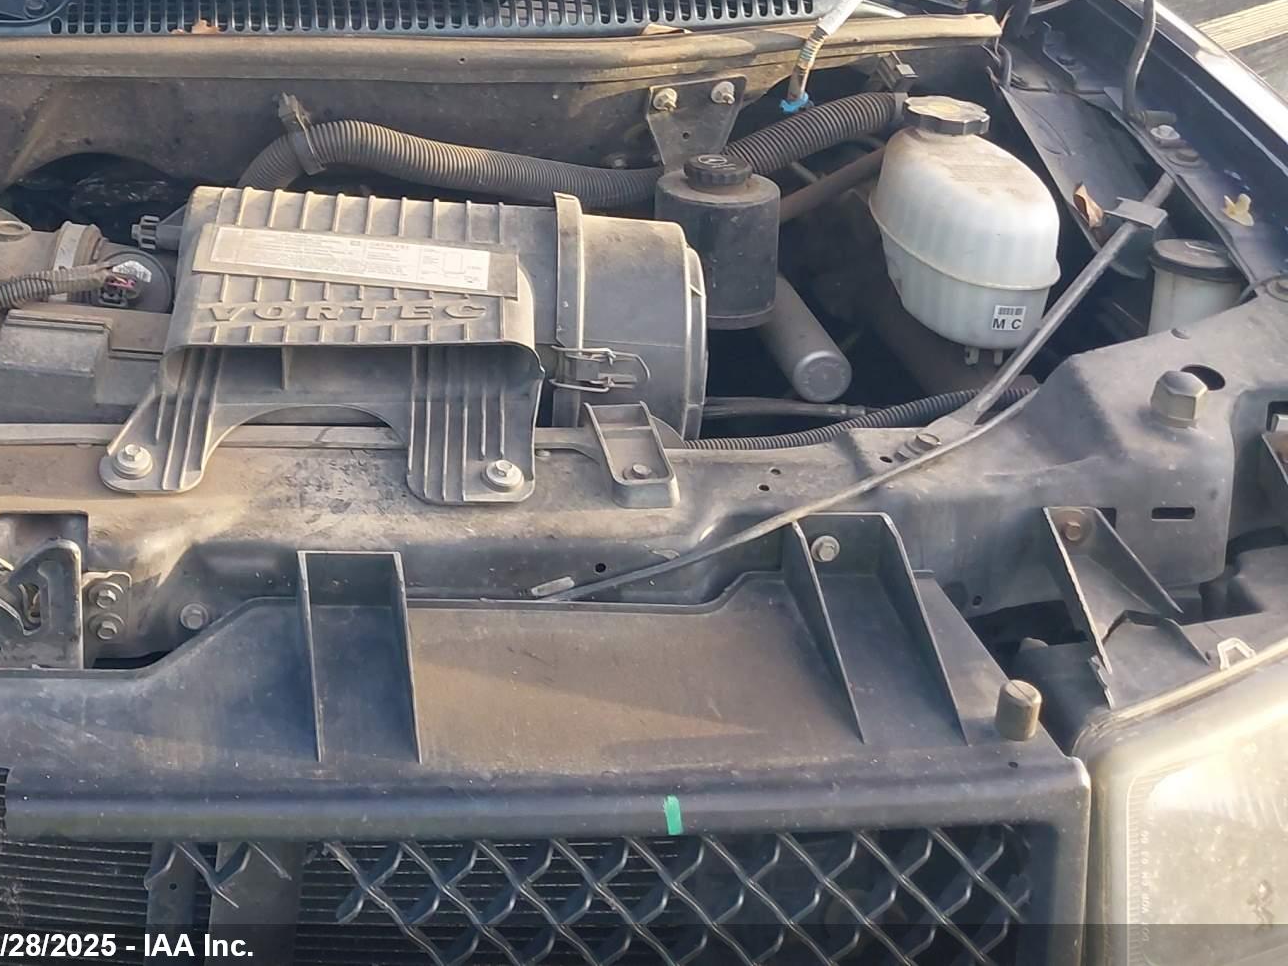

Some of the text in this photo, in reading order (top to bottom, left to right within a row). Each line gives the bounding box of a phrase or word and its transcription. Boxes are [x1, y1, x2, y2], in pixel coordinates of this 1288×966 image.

[211, 305, 487, 321] VORTEC
[992, 318, 1022, 329] M C
